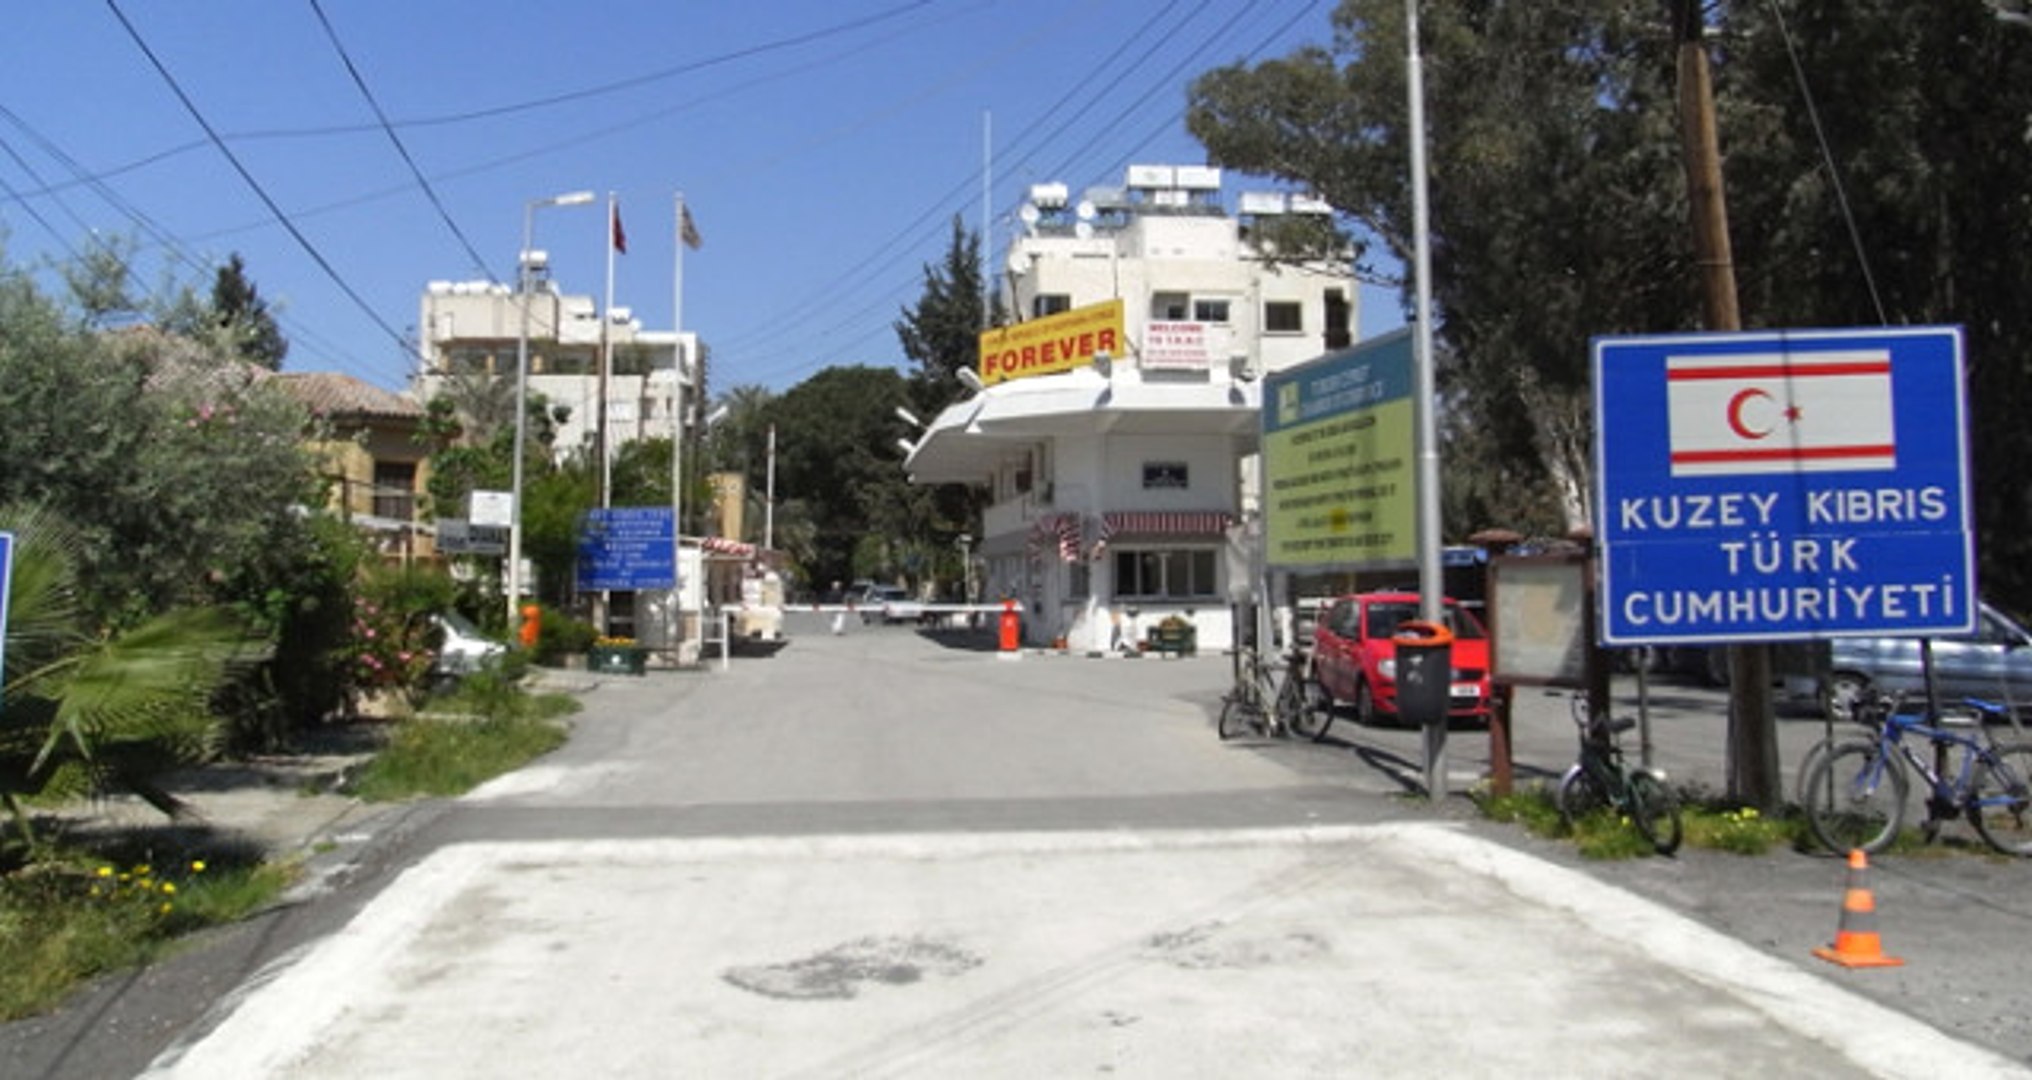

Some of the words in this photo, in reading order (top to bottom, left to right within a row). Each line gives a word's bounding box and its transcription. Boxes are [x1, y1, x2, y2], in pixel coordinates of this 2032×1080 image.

[1149, 324, 1204, 332] WELCOME
[984, 327, 1116, 376] FOREVER
[1621, 492, 1779, 531] KUZEY
[1806, 486, 1947, 524] KIBRIS
[1720, 531, 1861, 575] TÜRK
[1624, 575, 1955, 625] CUMHURİYETİ
